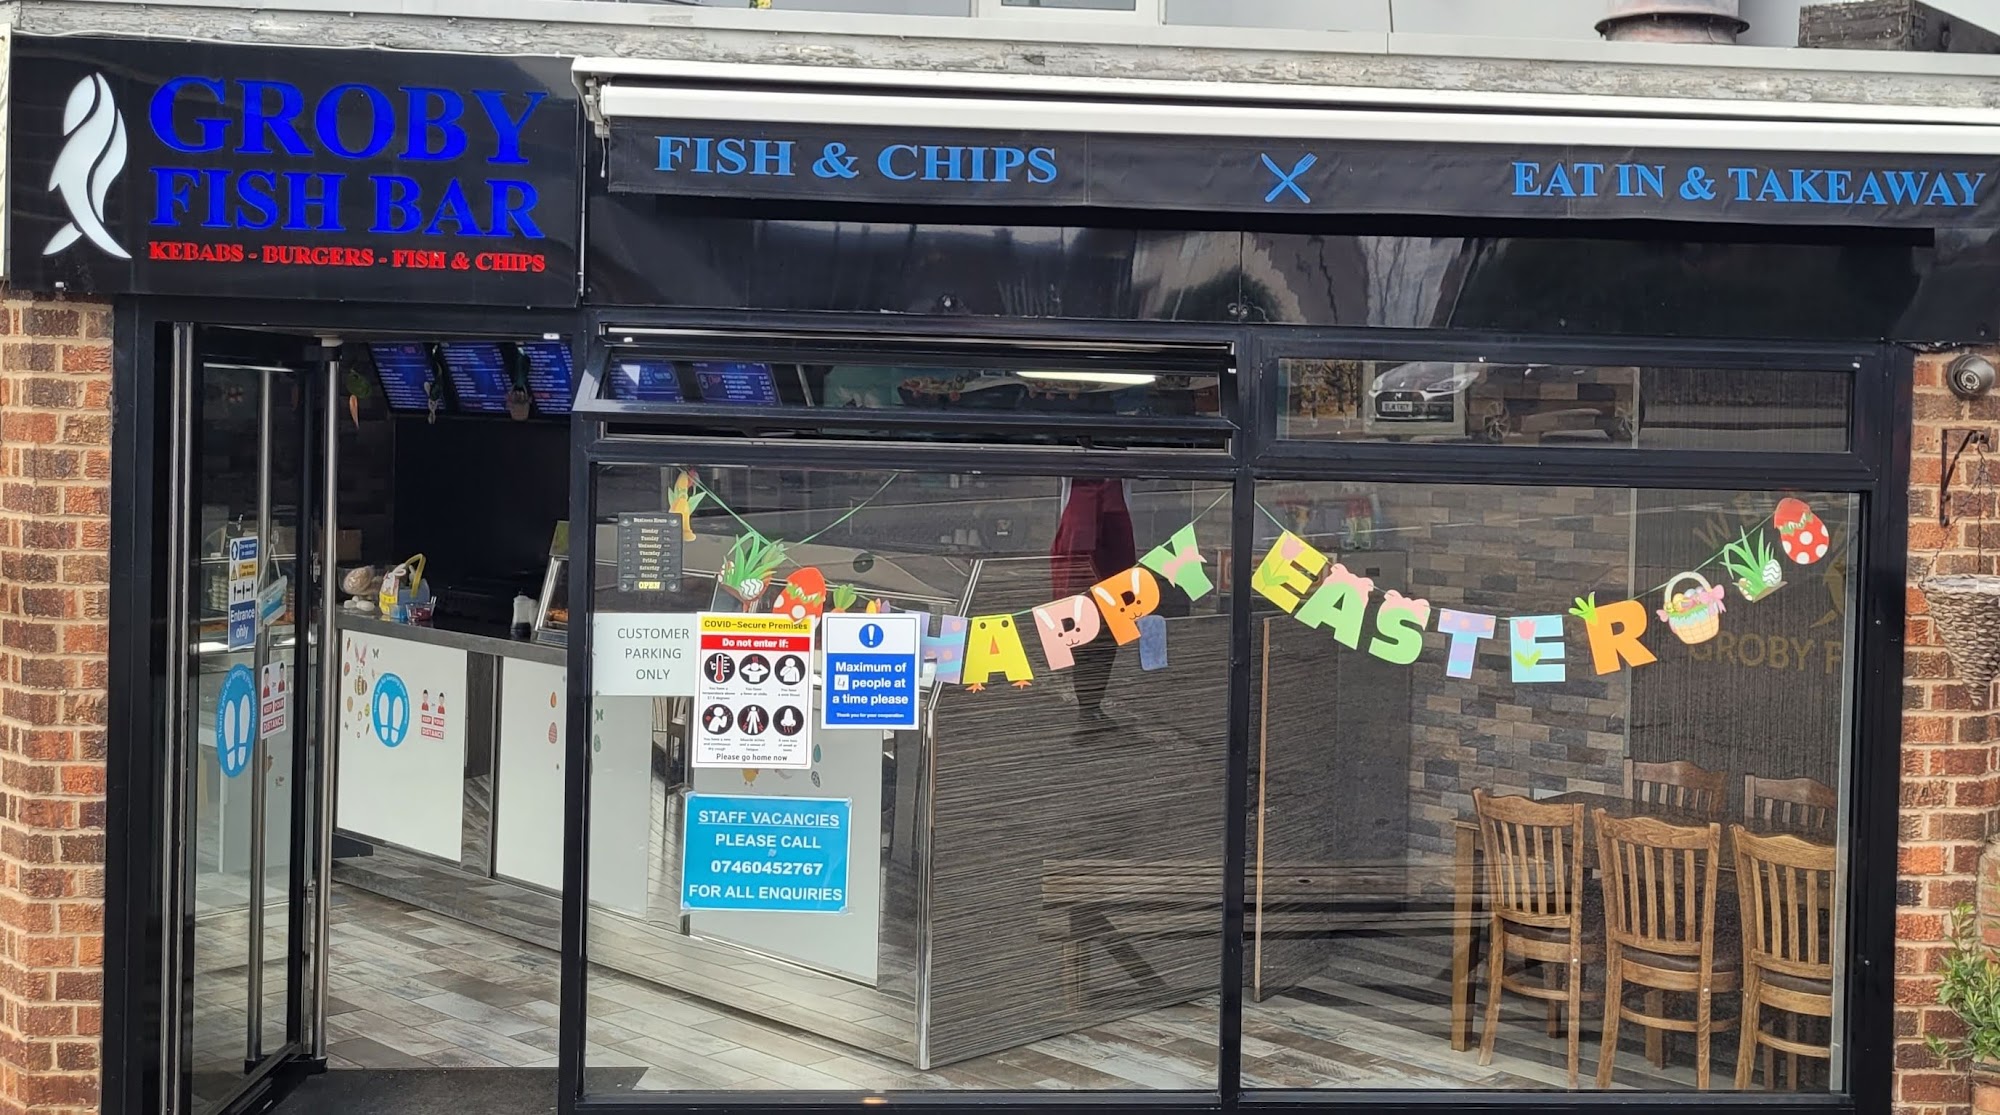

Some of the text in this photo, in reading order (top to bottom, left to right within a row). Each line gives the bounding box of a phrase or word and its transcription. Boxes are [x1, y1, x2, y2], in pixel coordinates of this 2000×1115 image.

[148, 75, 548, 164] GROBY
[654, 136, 1058, 183] FISH & CHIPS
[1512, 161, 1985, 206] EAT IN & TAKEAWAY
[148, 167, 546, 240] FISH BAR
[149, 242, 244, 262] KEBABS
[263, 245, 375, 267] BURGERS
[392, 249, 446, 269] FISH
[451, 251, 471, 270] &
[475, 252, 546, 272] CHIPS
[638, 581, 661, 590] OPEN
[920, 523, 1658, 684] HAPPY EASTER
[230, 606, 255, 623] Entrance
[236, 624, 249, 639] only
[768, 621, 808, 630] Premises
[617, 628, 690, 639] CUSTOMER
[722, 638, 735, 647] Do
[737, 639, 752, 648] not
[753, 640, 778, 648] enter
[625, 648, 682, 659] PARKING
[835, 661, 907, 672] Maximum of
[636, 669, 670, 680] ONLY
[852, 678, 891, 690] people
[894, 678, 906, 688] at
[264, 698, 284, 715] KEEP YOUR
[832, 694, 909, 706] a time please
[263, 715, 284, 733] DISTANCE
[698, 810, 840, 826] STAFF VACANCIES
[715, 833, 821, 848] PLEASE CALL
[711, 860, 823, 875] 07460452767
[689, 885, 842, 901] FOR ALL ENQUIRIES
